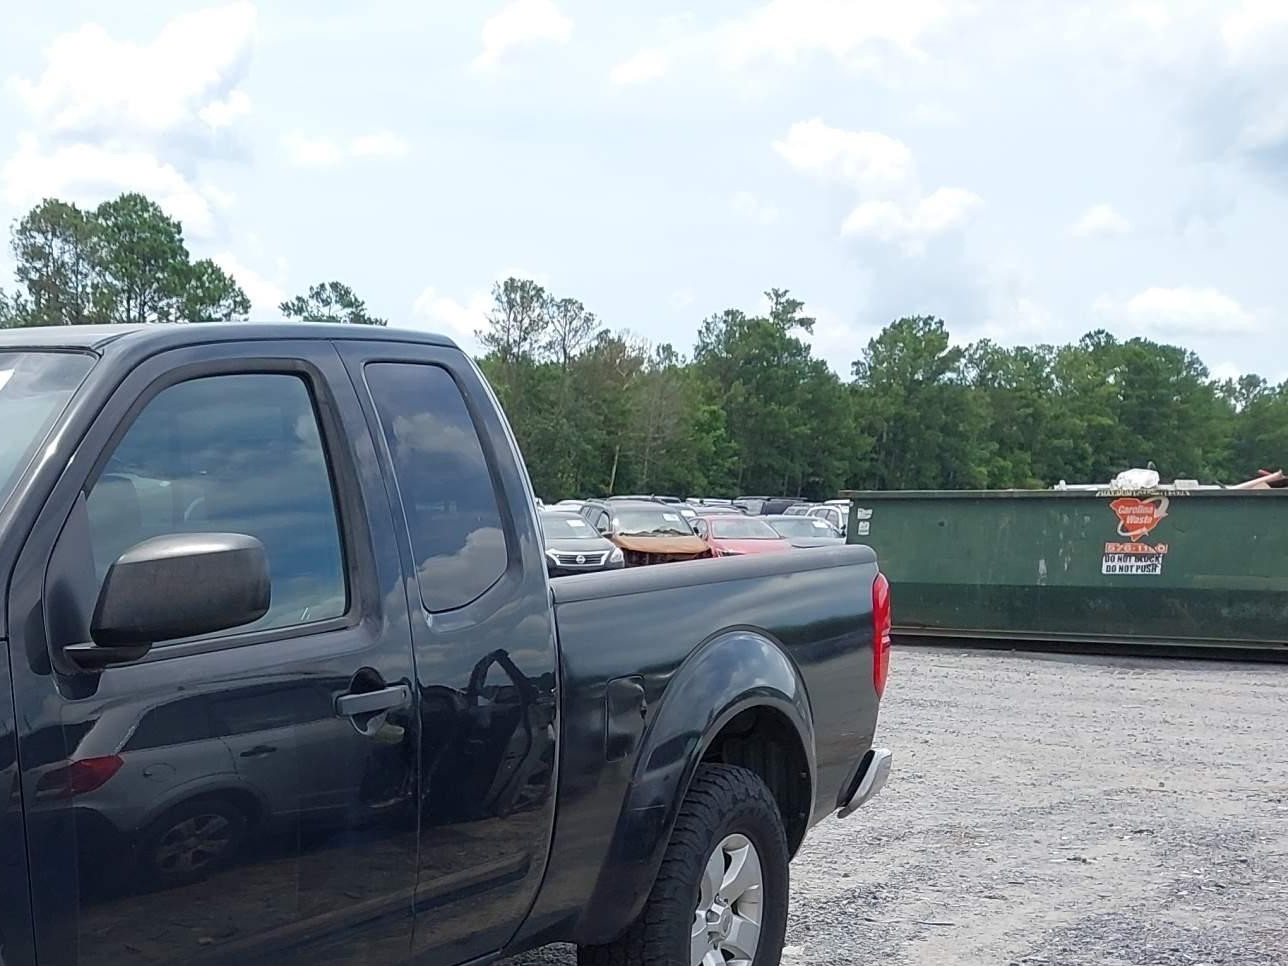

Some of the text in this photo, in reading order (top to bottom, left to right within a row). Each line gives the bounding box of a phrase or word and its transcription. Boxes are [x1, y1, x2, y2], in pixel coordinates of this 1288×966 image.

[1118, 505, 1153, 515] Carolina
[1127, 515, 1152, 524] Waste
[1136, 564, 1158, 572] PUSH
